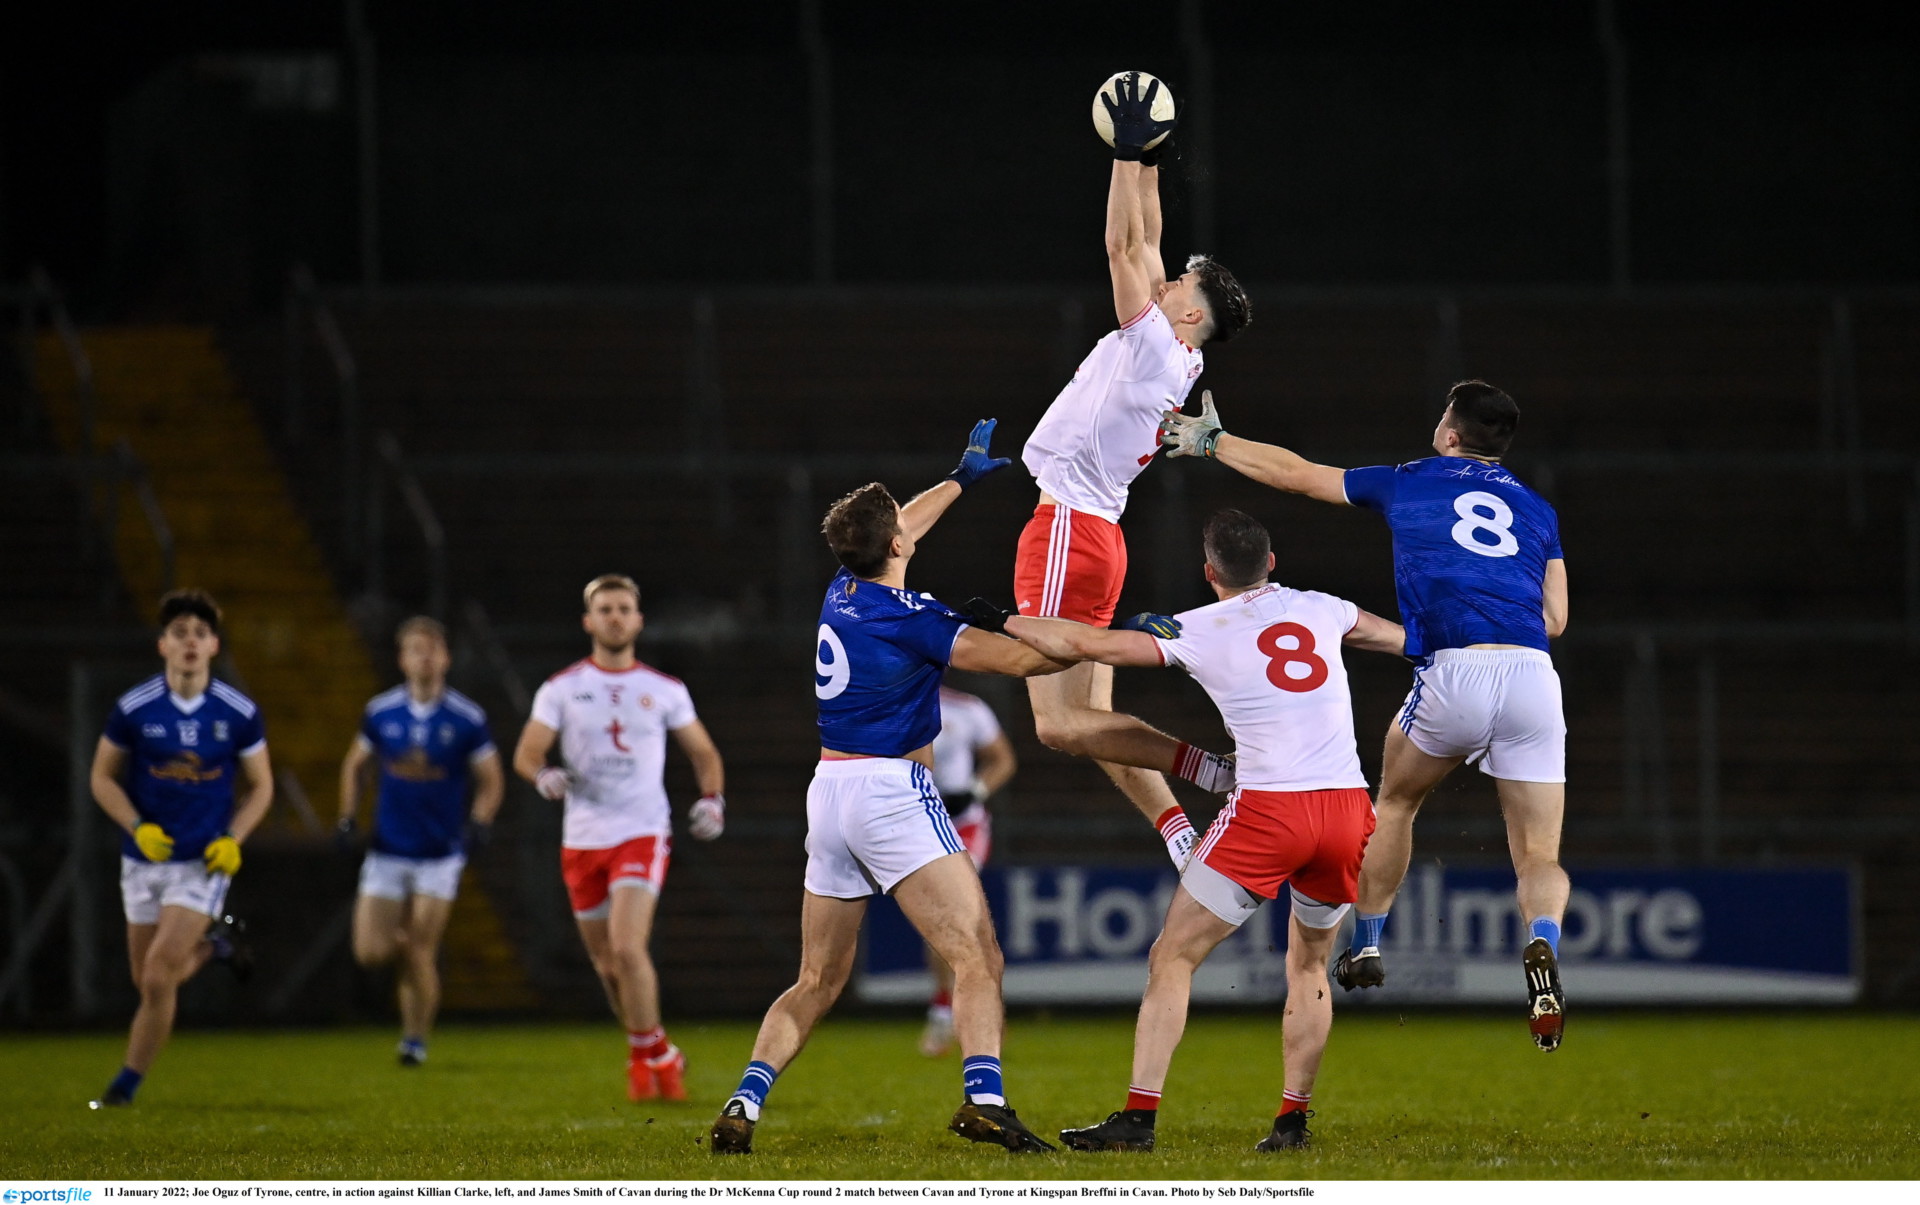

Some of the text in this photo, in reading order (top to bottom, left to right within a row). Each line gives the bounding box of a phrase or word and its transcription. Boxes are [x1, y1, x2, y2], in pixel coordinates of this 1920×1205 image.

[1450, 490, 1520, 558] 8
[815, 623, 851, 700] 9
[1256, 621, 1329, 693] 8
[1340, 865, 1704, 957] ilmore
